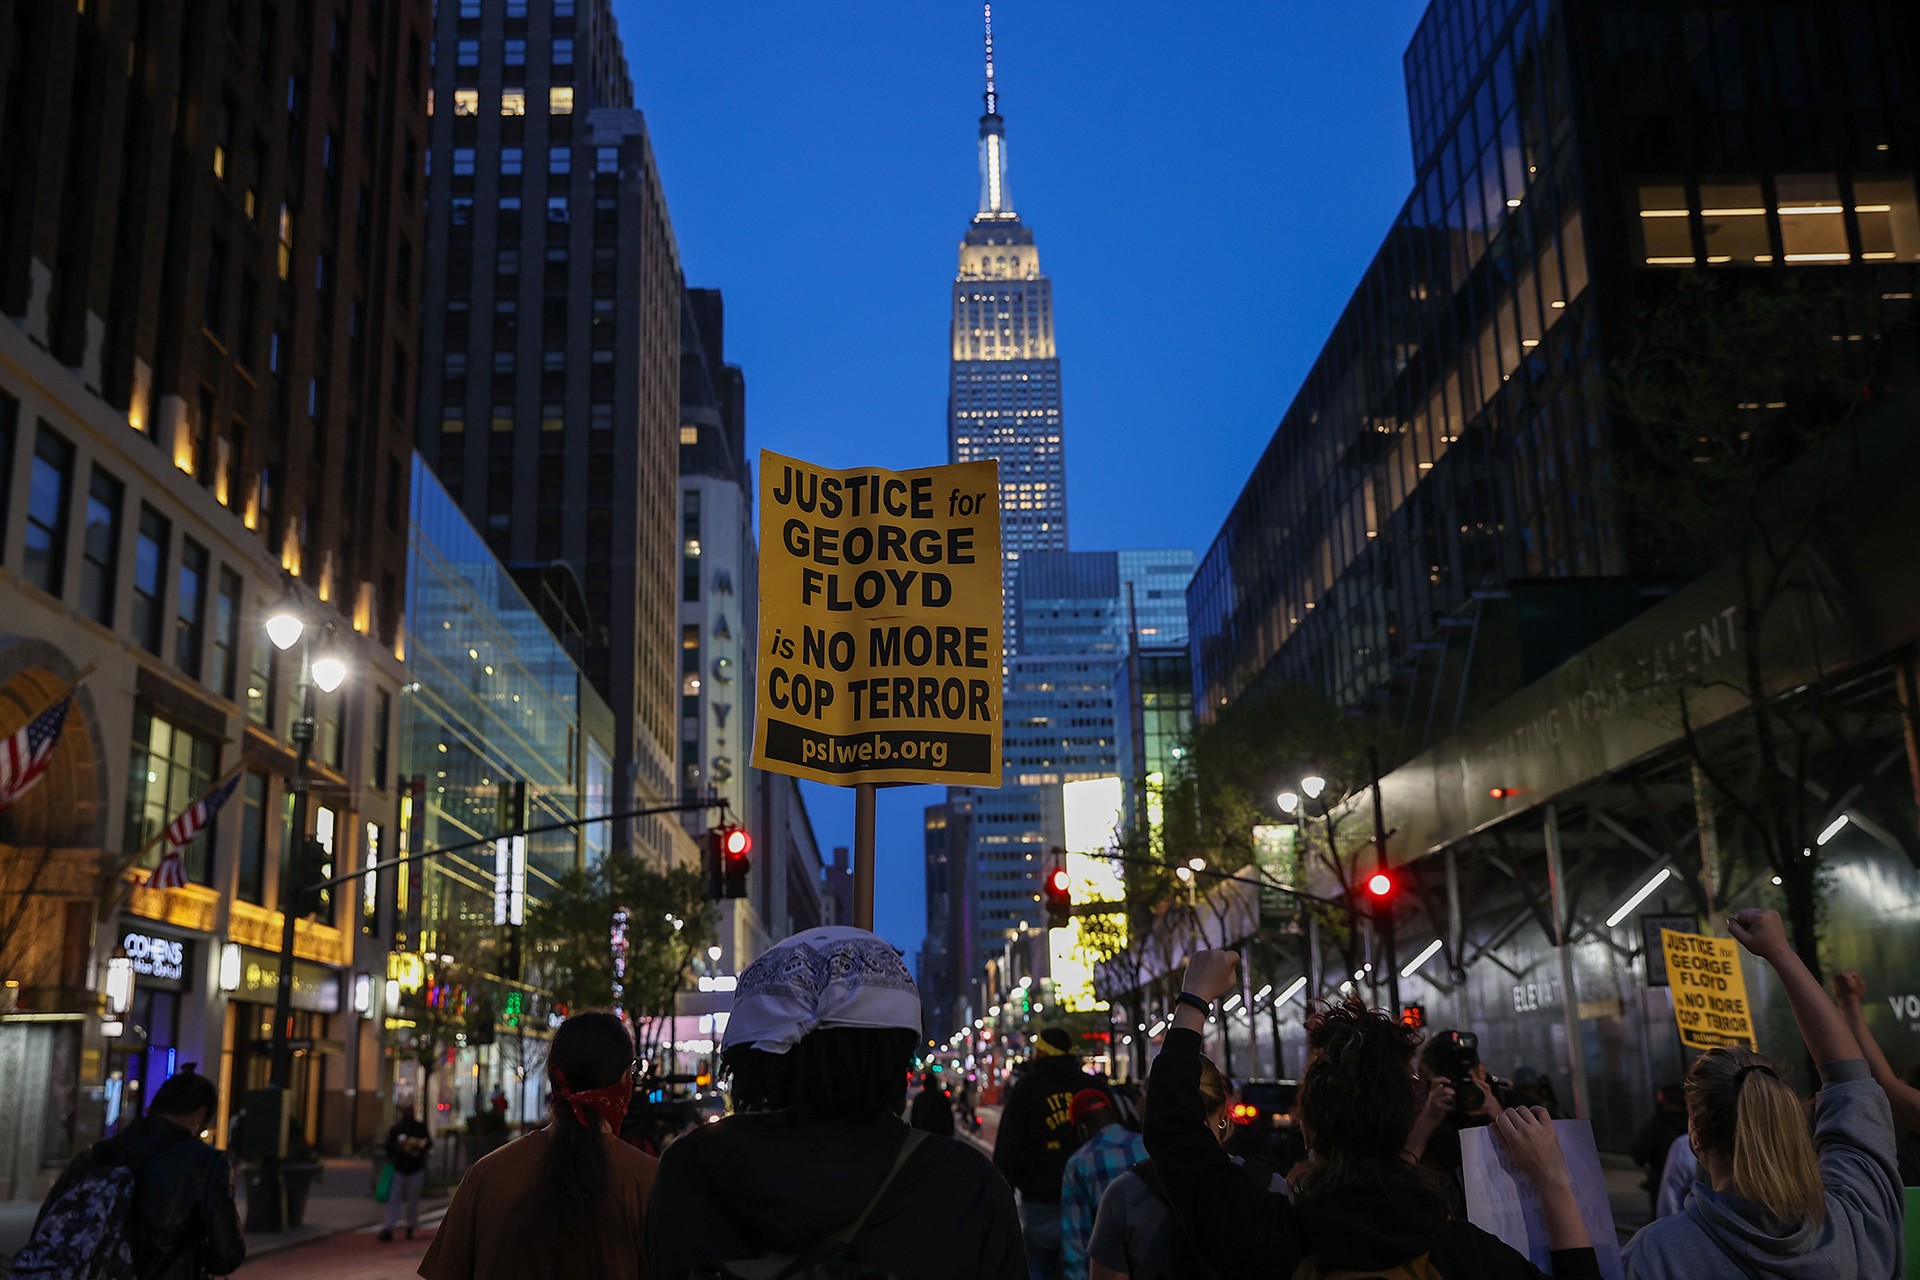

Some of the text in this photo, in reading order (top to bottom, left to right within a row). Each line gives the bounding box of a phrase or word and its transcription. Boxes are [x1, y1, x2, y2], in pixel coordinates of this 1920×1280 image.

[773, 465, 986, 519] JUSTICE for
[783, 518, 975, 566] GEORGE
[802, 566, 952, 612] FLOYD
[771, 624, 988, 673] is NO MORE
[768, 666, 991, 722] COP TERROR
[802, 735, 948, 767] pslweb.org
[123, 932, 184, 966] COHENS
[1666, 934, 1715, 957] JUSTICE
[1671, 953, 1733, 976] GEORGE
[1680, 971, 1728, 991] FLOYD
[1684, 991, 1706, 1008] NO
[1707, 996, 1744, 1014] MORE
[1678, 1008, 1749, 1032] COP TERROR
